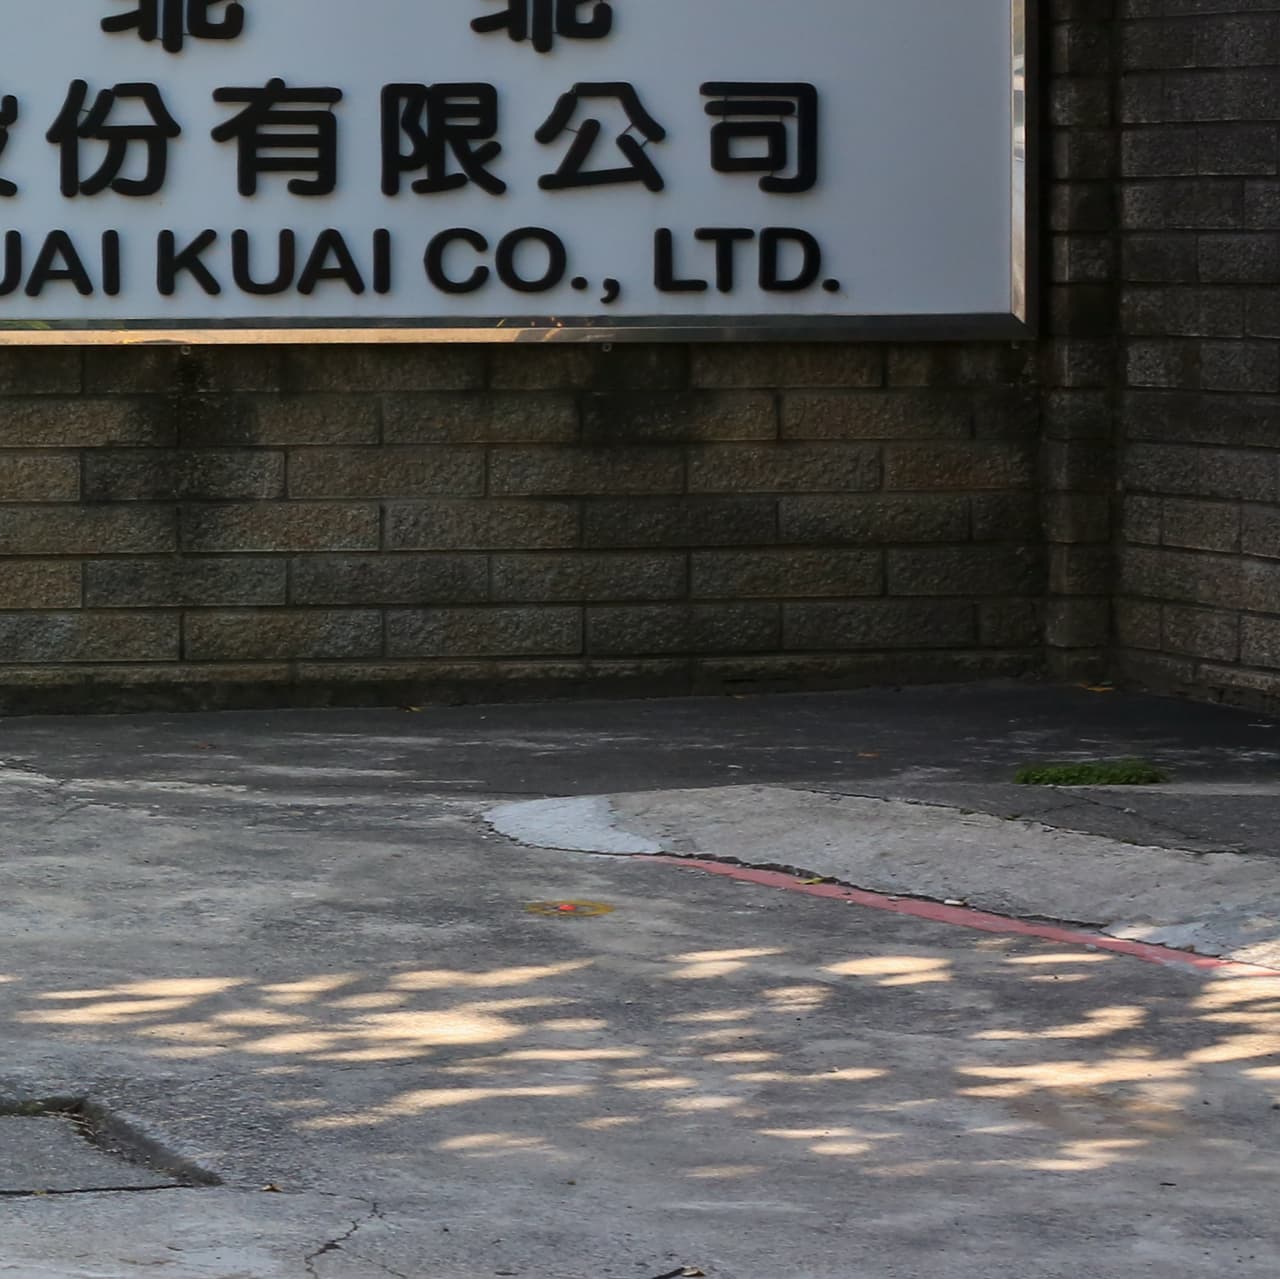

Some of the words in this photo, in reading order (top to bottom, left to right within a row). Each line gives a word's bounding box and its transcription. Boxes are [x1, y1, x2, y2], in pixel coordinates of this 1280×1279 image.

[156, 228, 392, 297] KUAI
[423, 226, 622, 306] CO.,
[653, 226, 841, 295] LTD.
